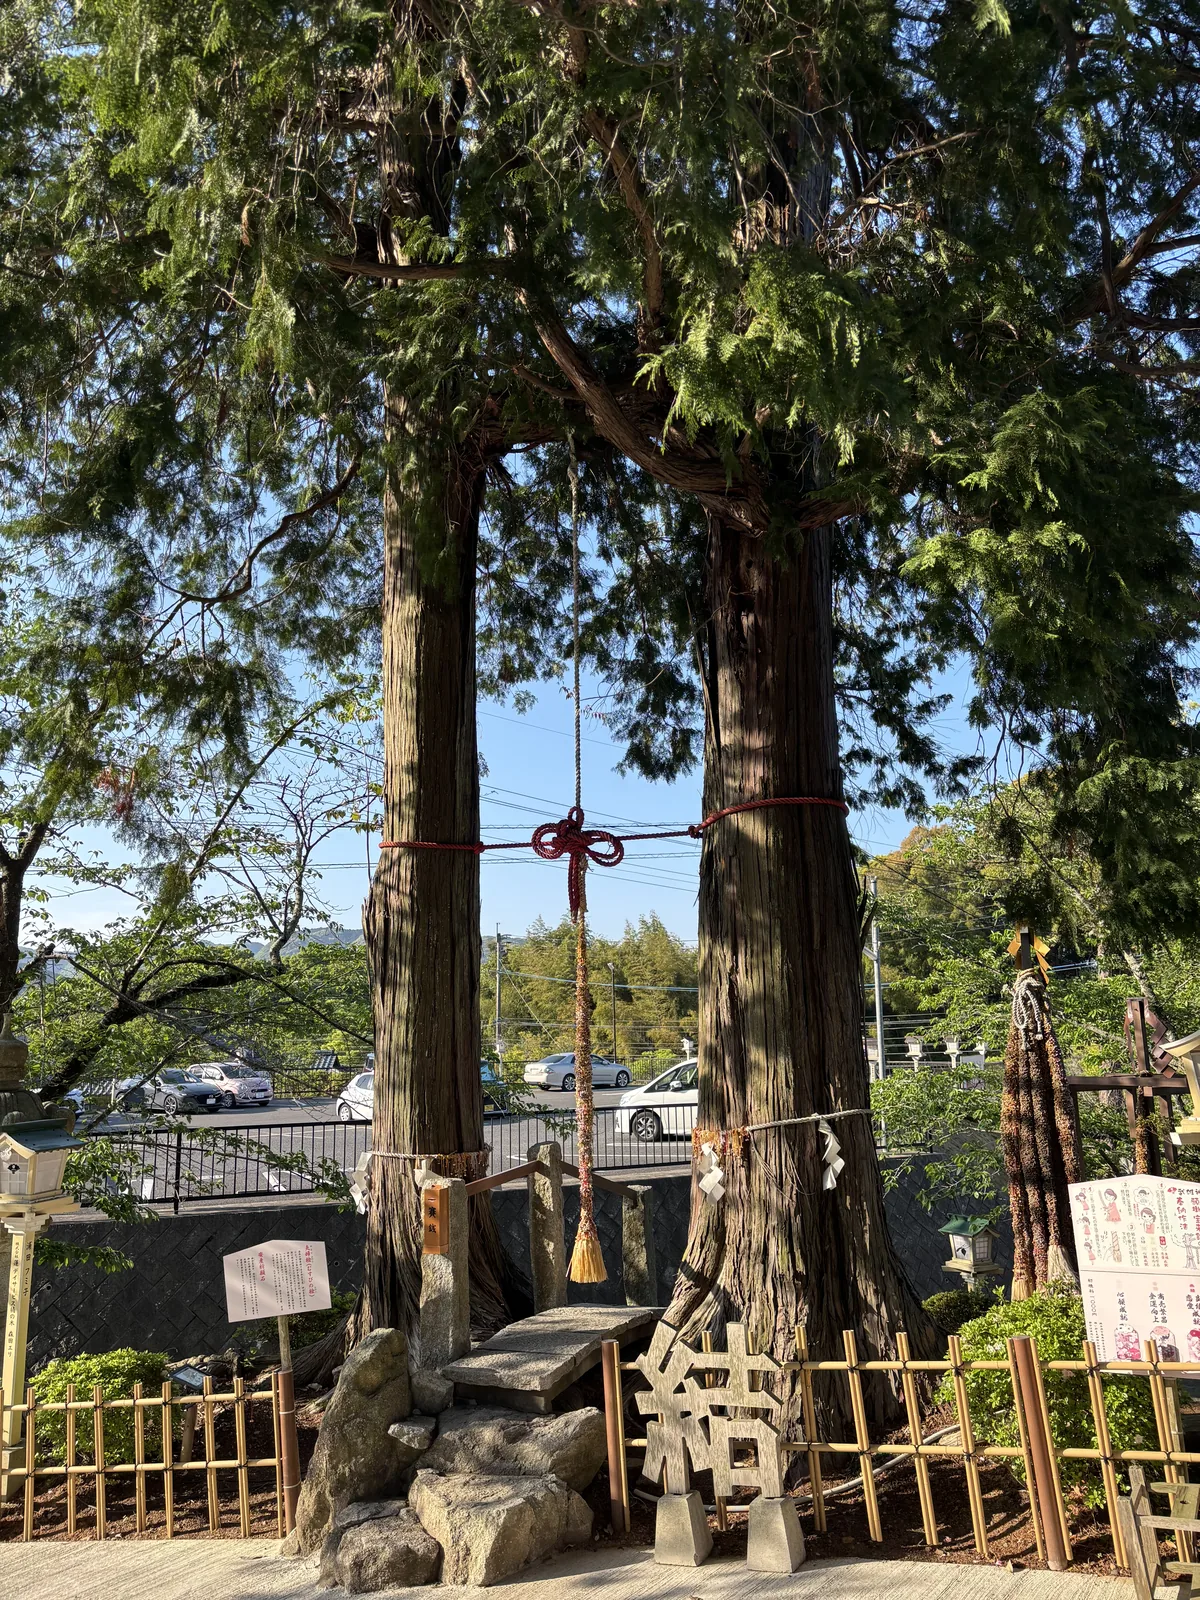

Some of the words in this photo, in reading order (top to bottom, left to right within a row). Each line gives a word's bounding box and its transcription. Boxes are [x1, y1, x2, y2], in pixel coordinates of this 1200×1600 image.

[1116, 1291, 1129, 1321] 心願成就
[1149, 1292, 1160, 1323] 金運向上
[634, 1319, 785, 1499] 結
